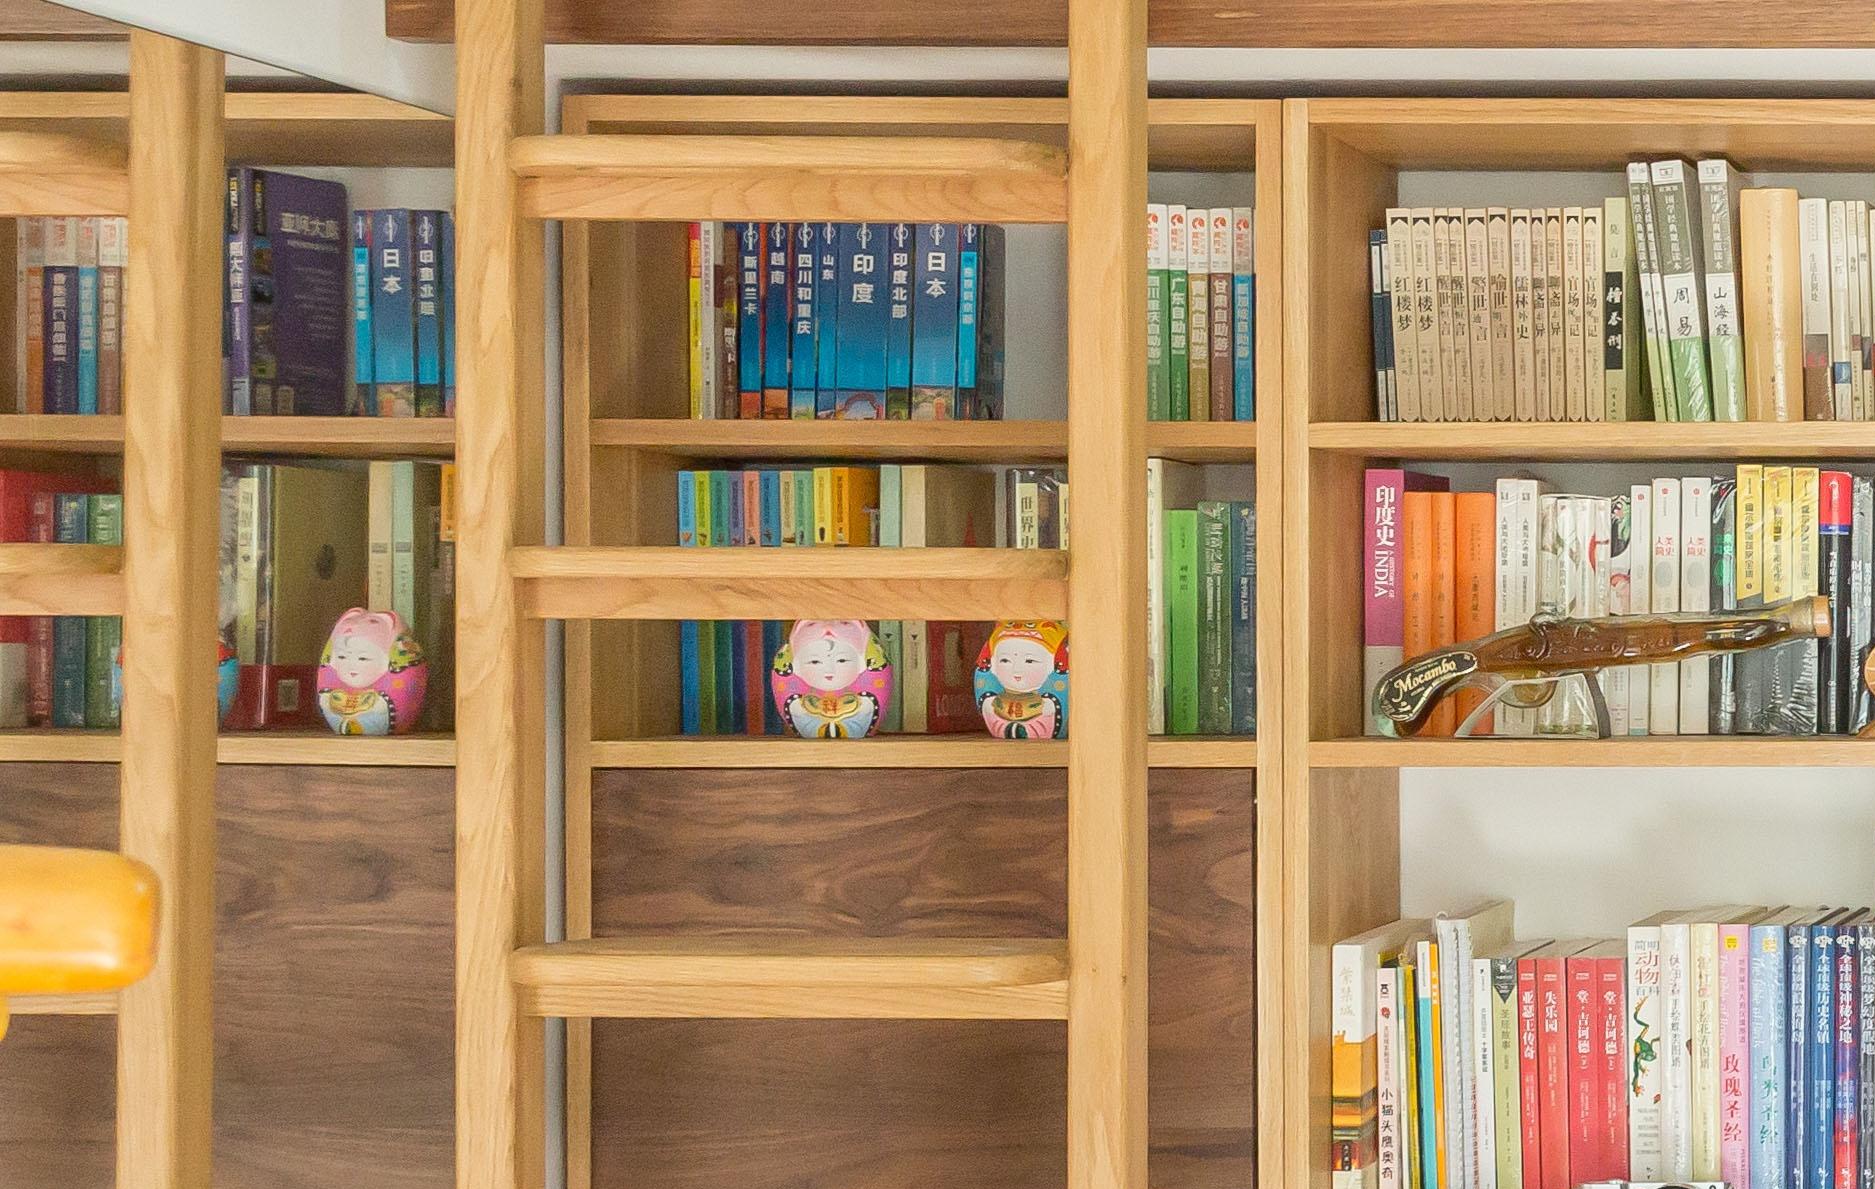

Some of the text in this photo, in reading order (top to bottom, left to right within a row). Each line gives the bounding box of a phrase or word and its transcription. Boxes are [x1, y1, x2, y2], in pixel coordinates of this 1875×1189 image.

[796, 254, 812, 335] 四川和重庆
[852, 254, 875, 304] 印度
[891, 253, 908, 320] 印度北部
[926, 252, 947, 298] 日本
[1394, 276, 1413, 332] 红楼梦
[1416, 276, 1434, 332] 红楼梦
[1673, 286, 1692, 337] 周易
[1375, 485, 1396, 547] 印度史
[1374, 551, 1389, 598] INDIA
[1392, 658, 1458, 702] Mocambo
[1522, 990, 1535, 1060] 亚瑟王传奇
[1544, 990, 1558, 1032] 失乐园
[1723, 1054, 1743, 1143] 玫瑰圣经
